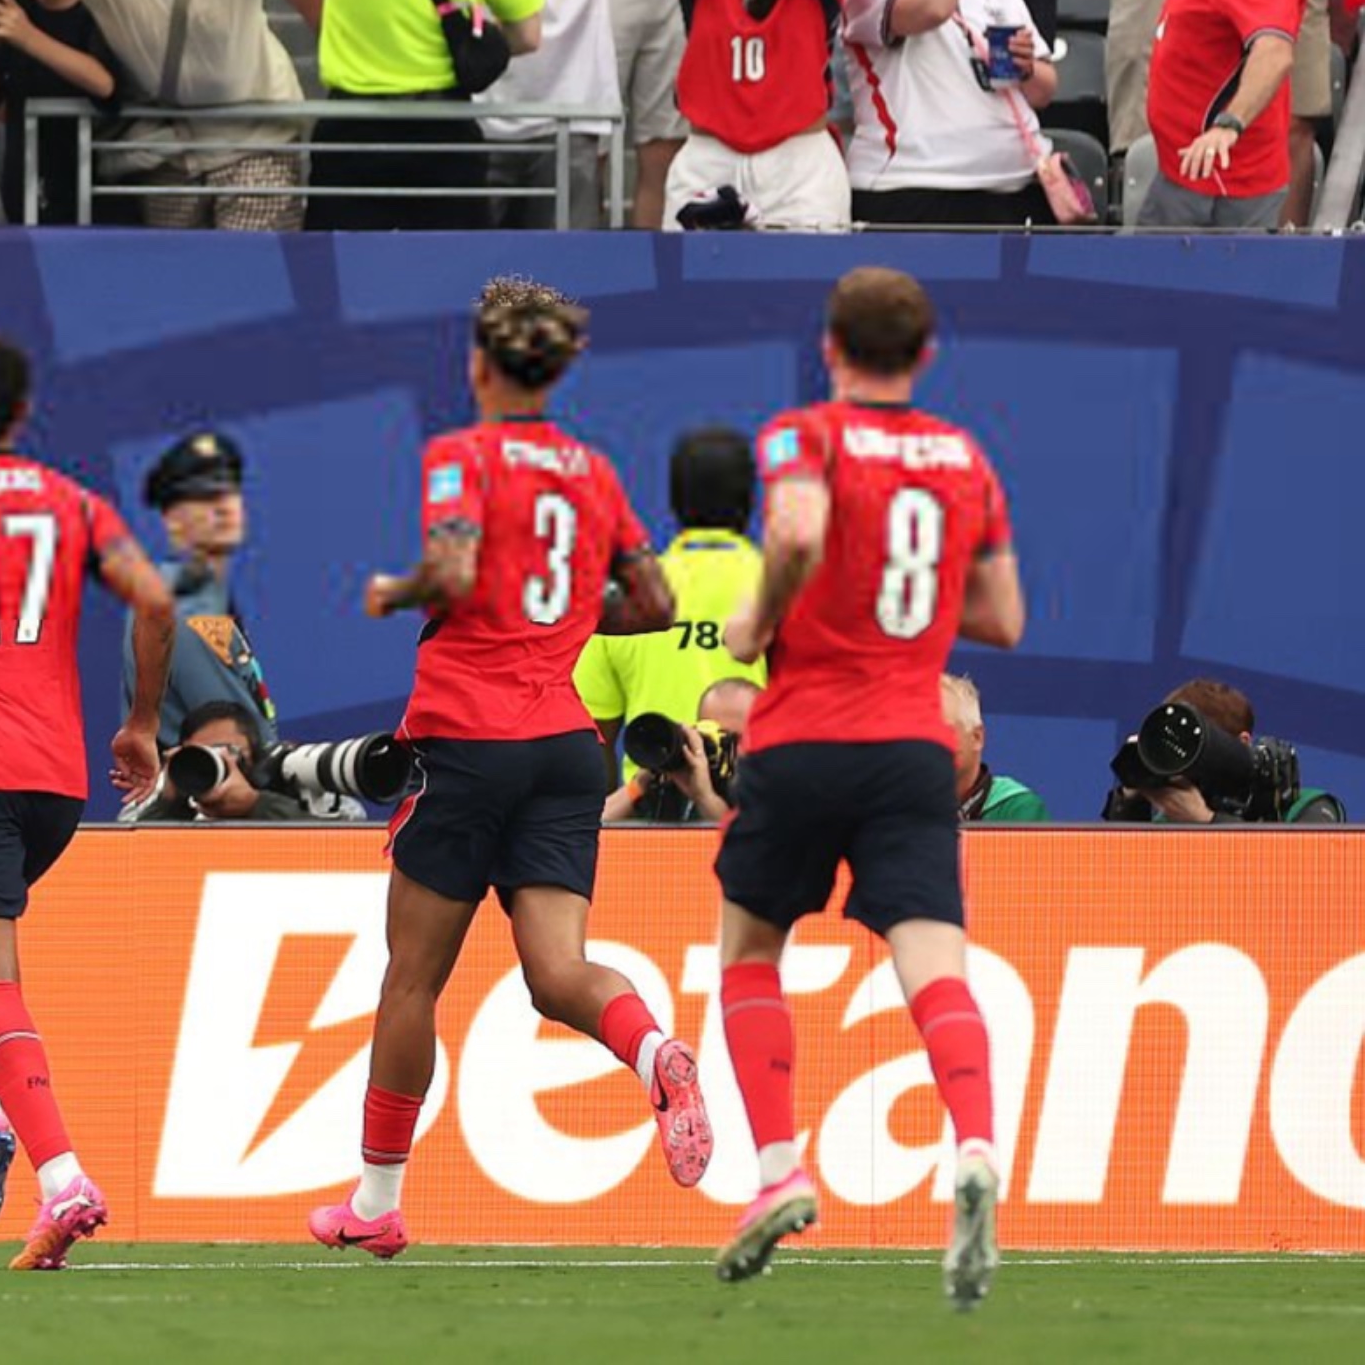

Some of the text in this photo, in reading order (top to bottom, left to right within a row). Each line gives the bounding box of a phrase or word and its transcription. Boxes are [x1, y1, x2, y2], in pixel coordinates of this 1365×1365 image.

[731, 35, 765, 82] 10
[522, 490, 577, 627] 3
[875, 485, 945, 639] 8
[674, 620, 726, 651] 78
